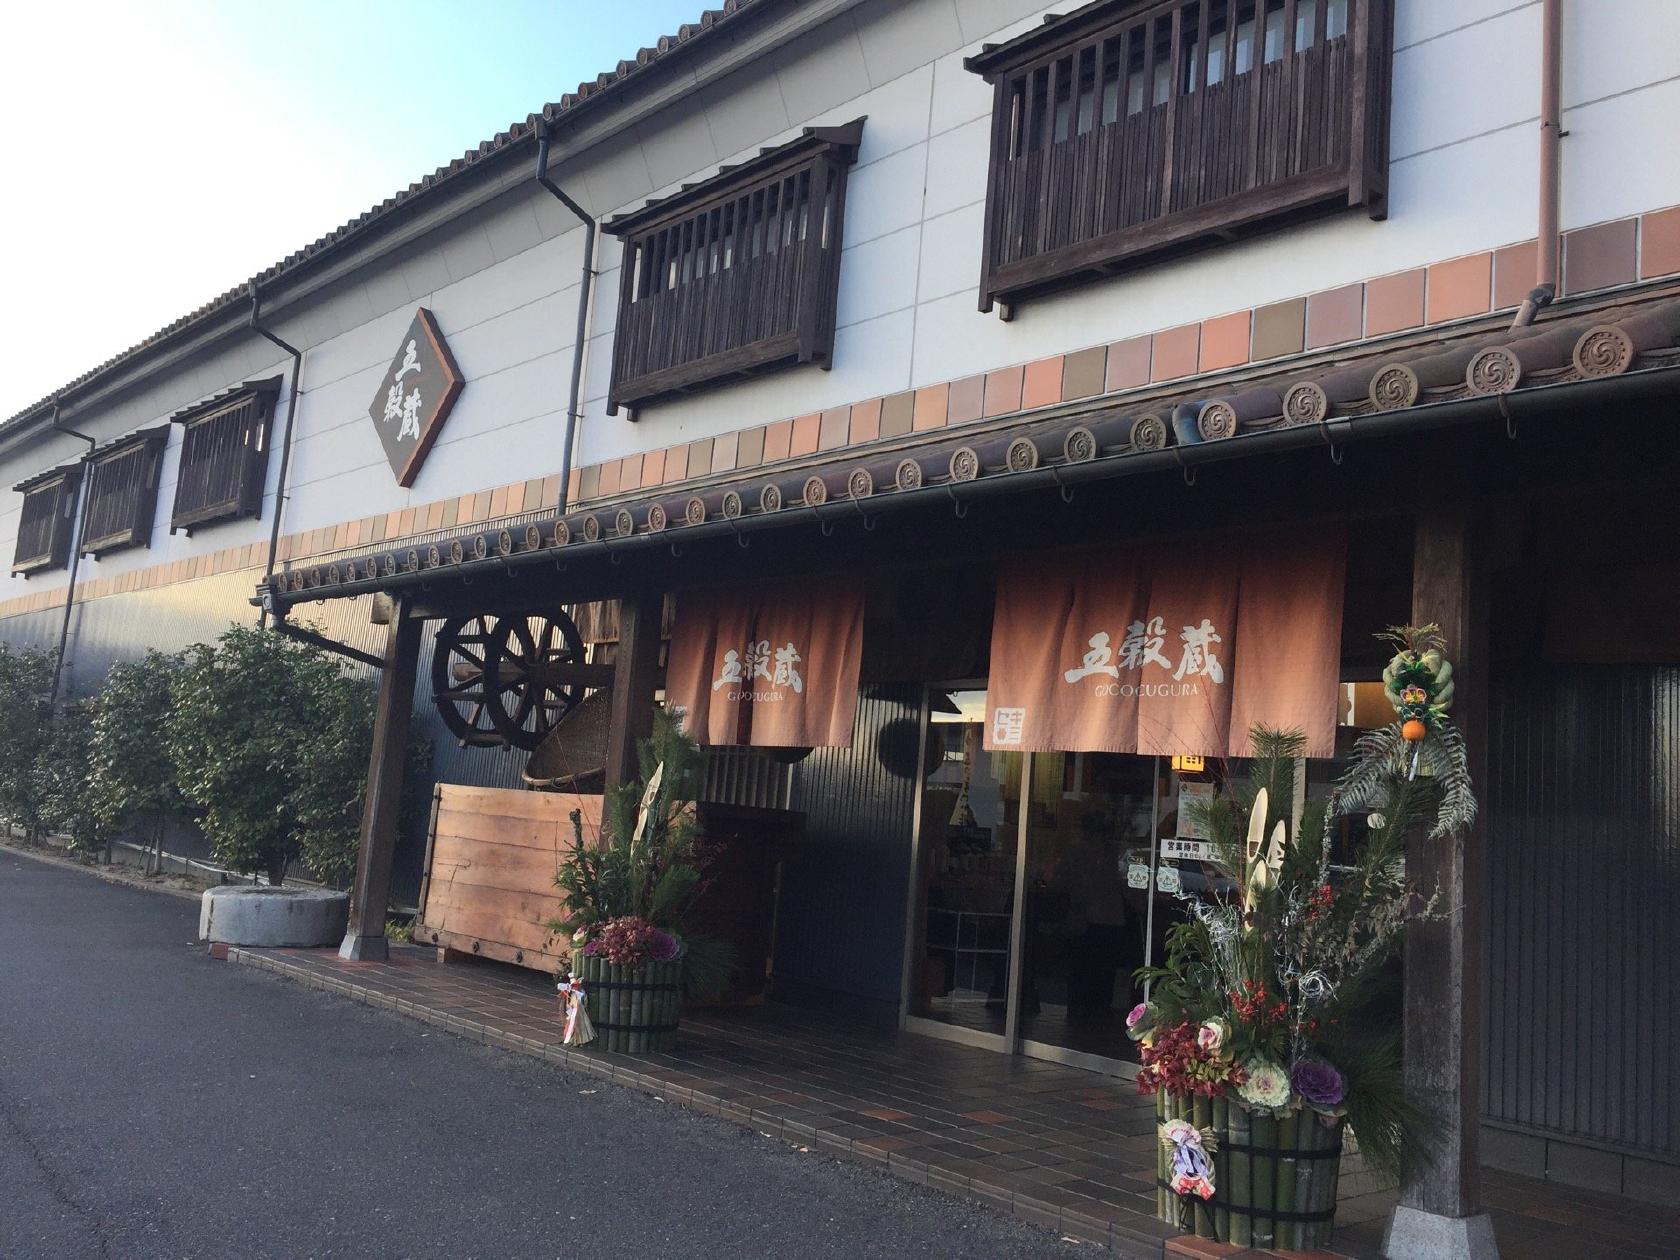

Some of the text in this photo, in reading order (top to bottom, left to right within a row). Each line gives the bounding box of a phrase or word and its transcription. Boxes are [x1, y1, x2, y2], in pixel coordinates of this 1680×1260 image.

[384, 339, 422, 442] 五穀蔵
[713, 640, 803, 693] 五穀蔵
[1064, 616, 1224, 684] 五穀蔵
